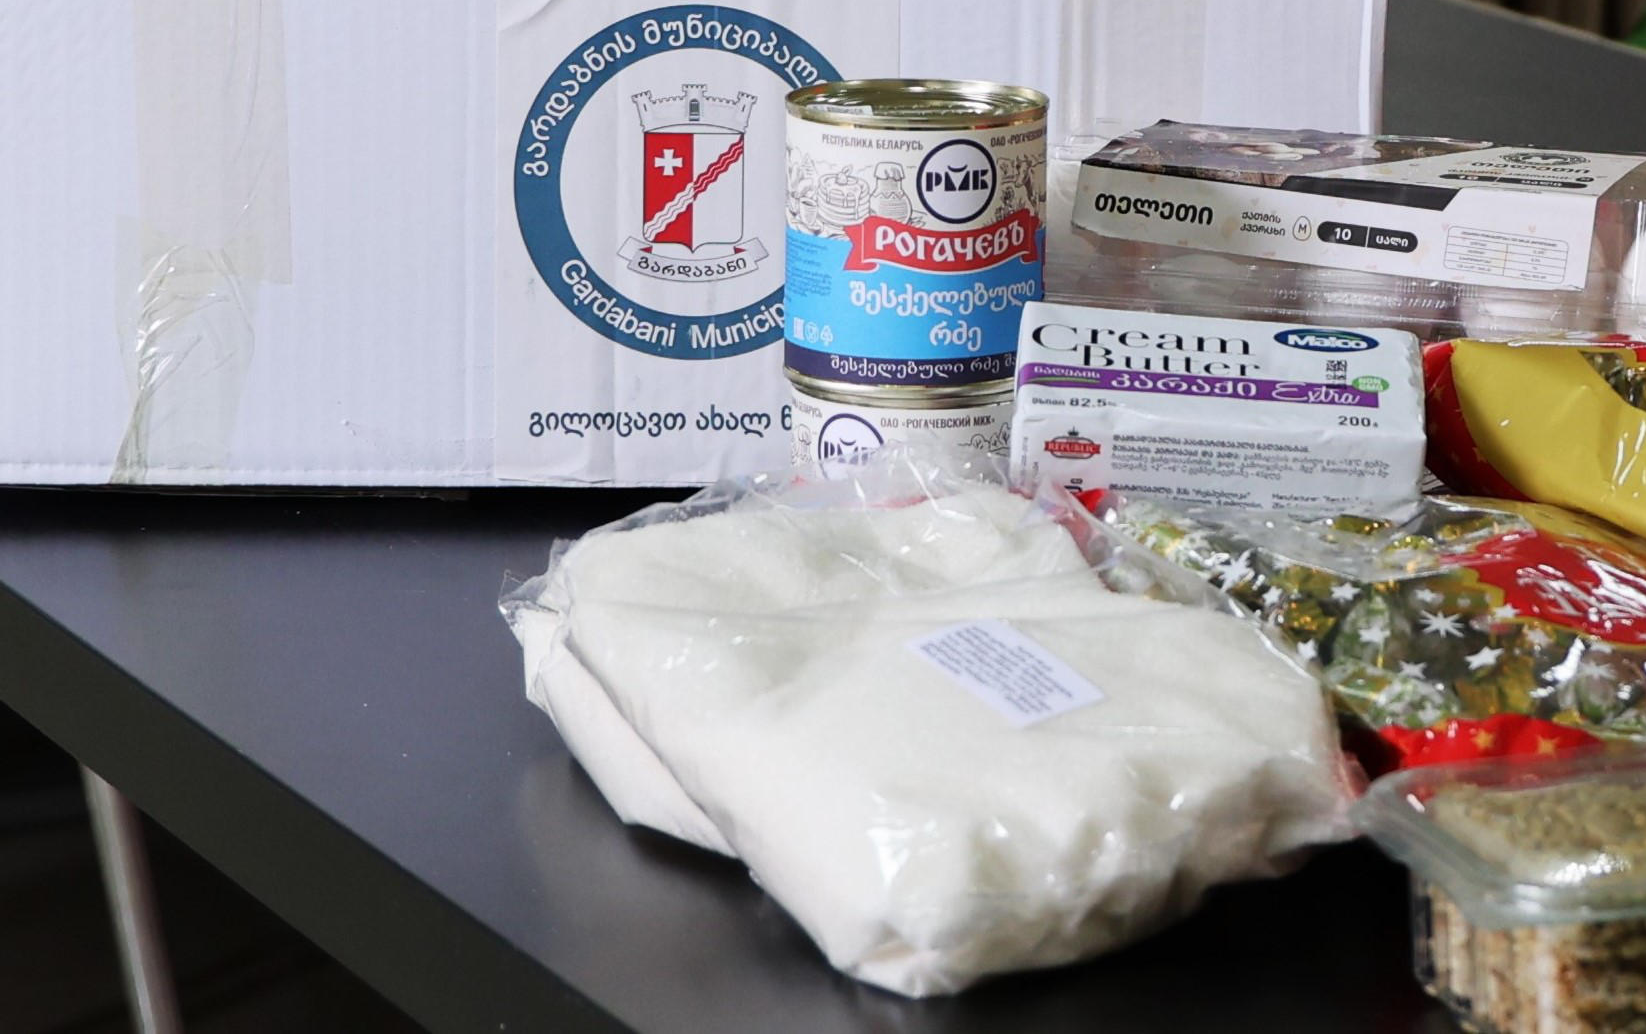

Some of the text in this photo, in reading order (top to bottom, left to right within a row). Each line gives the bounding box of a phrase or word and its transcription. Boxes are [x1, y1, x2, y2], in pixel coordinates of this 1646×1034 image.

[522, 12, 828, 178] გარდაბნის მუნიციპალ
[821, 133, 924, 152] РЕСПУБЛИКА БЕЛАРУСЬ
[1094, 192, 1214, 226] თელეთი
[1298, 224, 1307, 234] M
[1334, 227, 1410, 248] 10 ცალი
[559, 258, 677, 349] Gardabani
[848, 278, 1036, 317] შესქელებული
[928, 320, 982, 352] რძე
[1032, 322, 1256, 356] Cream
[829, 353, 965, 378] შესქელებული
[970, 353, 1000, 373] რძე
[1077, 344, 1261, 377] Butter
[1271, 381, 1361, 404] Extra
[527, 409, 687, 438] გილოცავთ
[694, 403, 773, 438] ახალ
[880, 417, 899, 427] ОАО
